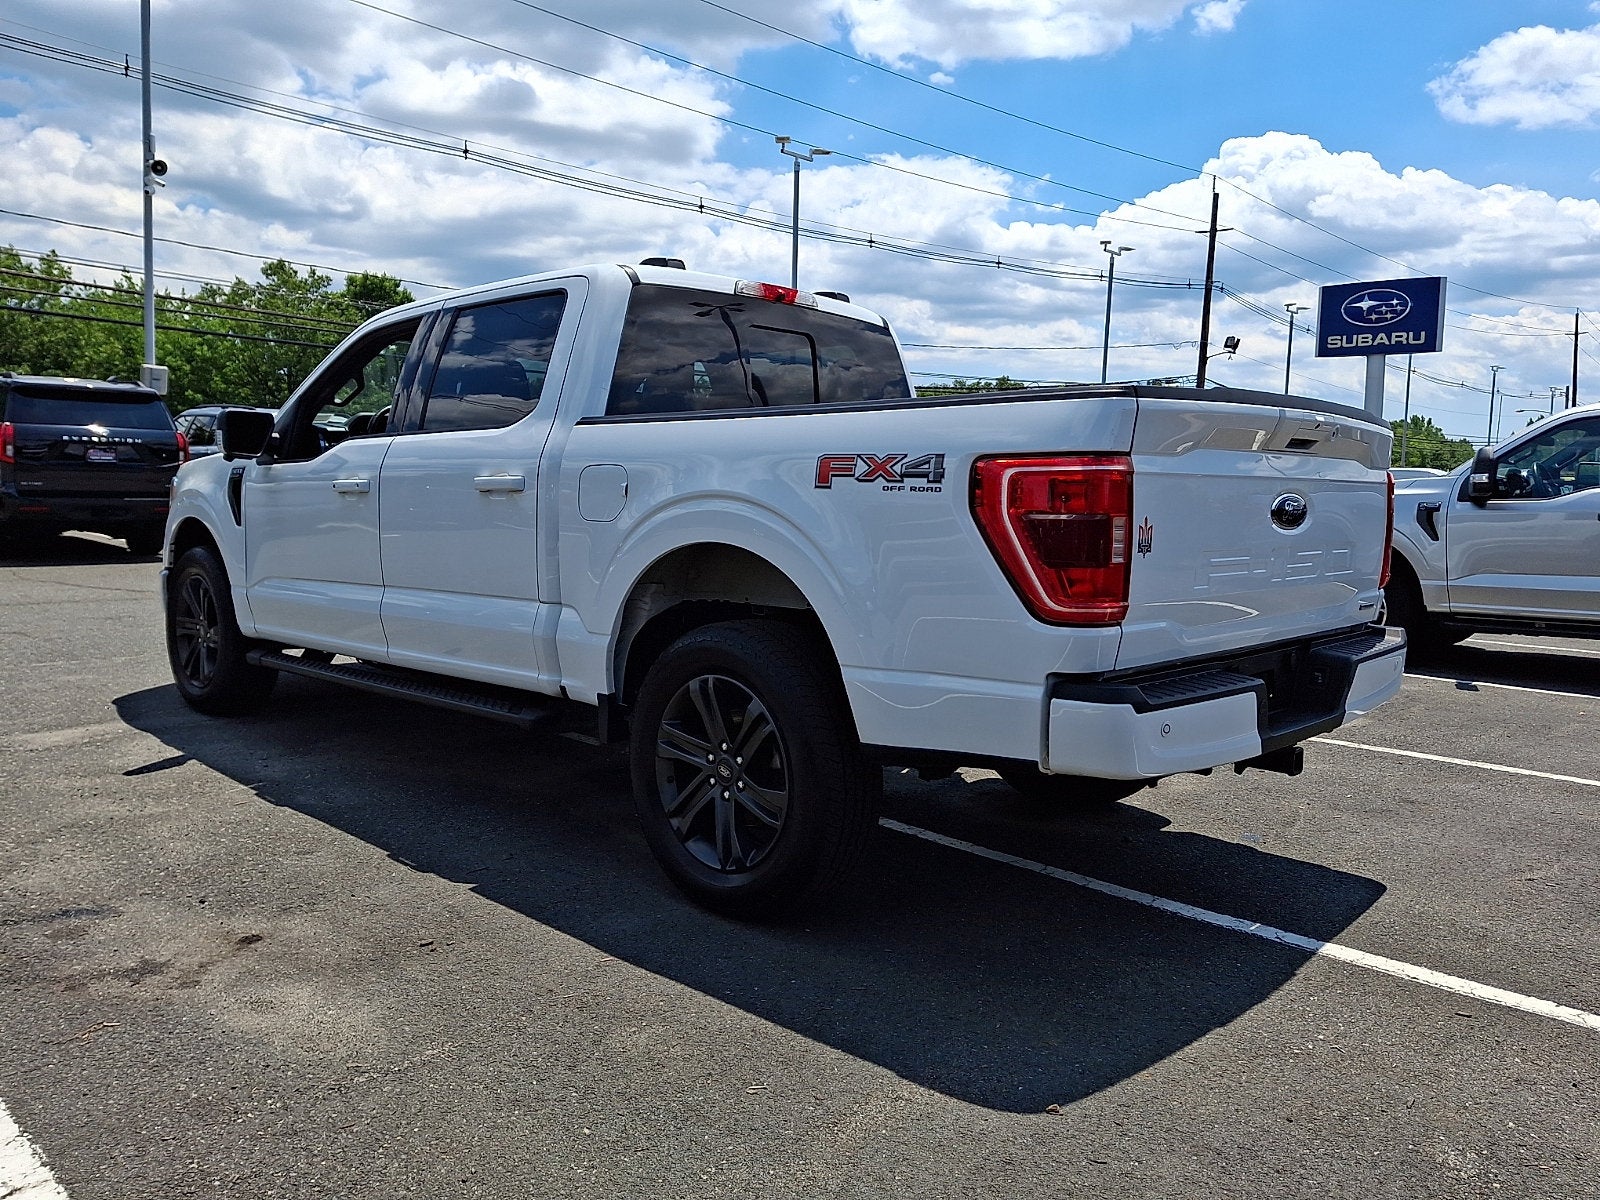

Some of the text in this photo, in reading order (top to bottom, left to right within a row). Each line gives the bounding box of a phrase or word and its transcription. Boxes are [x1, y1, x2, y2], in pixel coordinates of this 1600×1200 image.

[1326, 331, 1426, 349] SUBARU
[814, 453, 946, 489] FX4
[909, 485, 942, 493] ROAD
